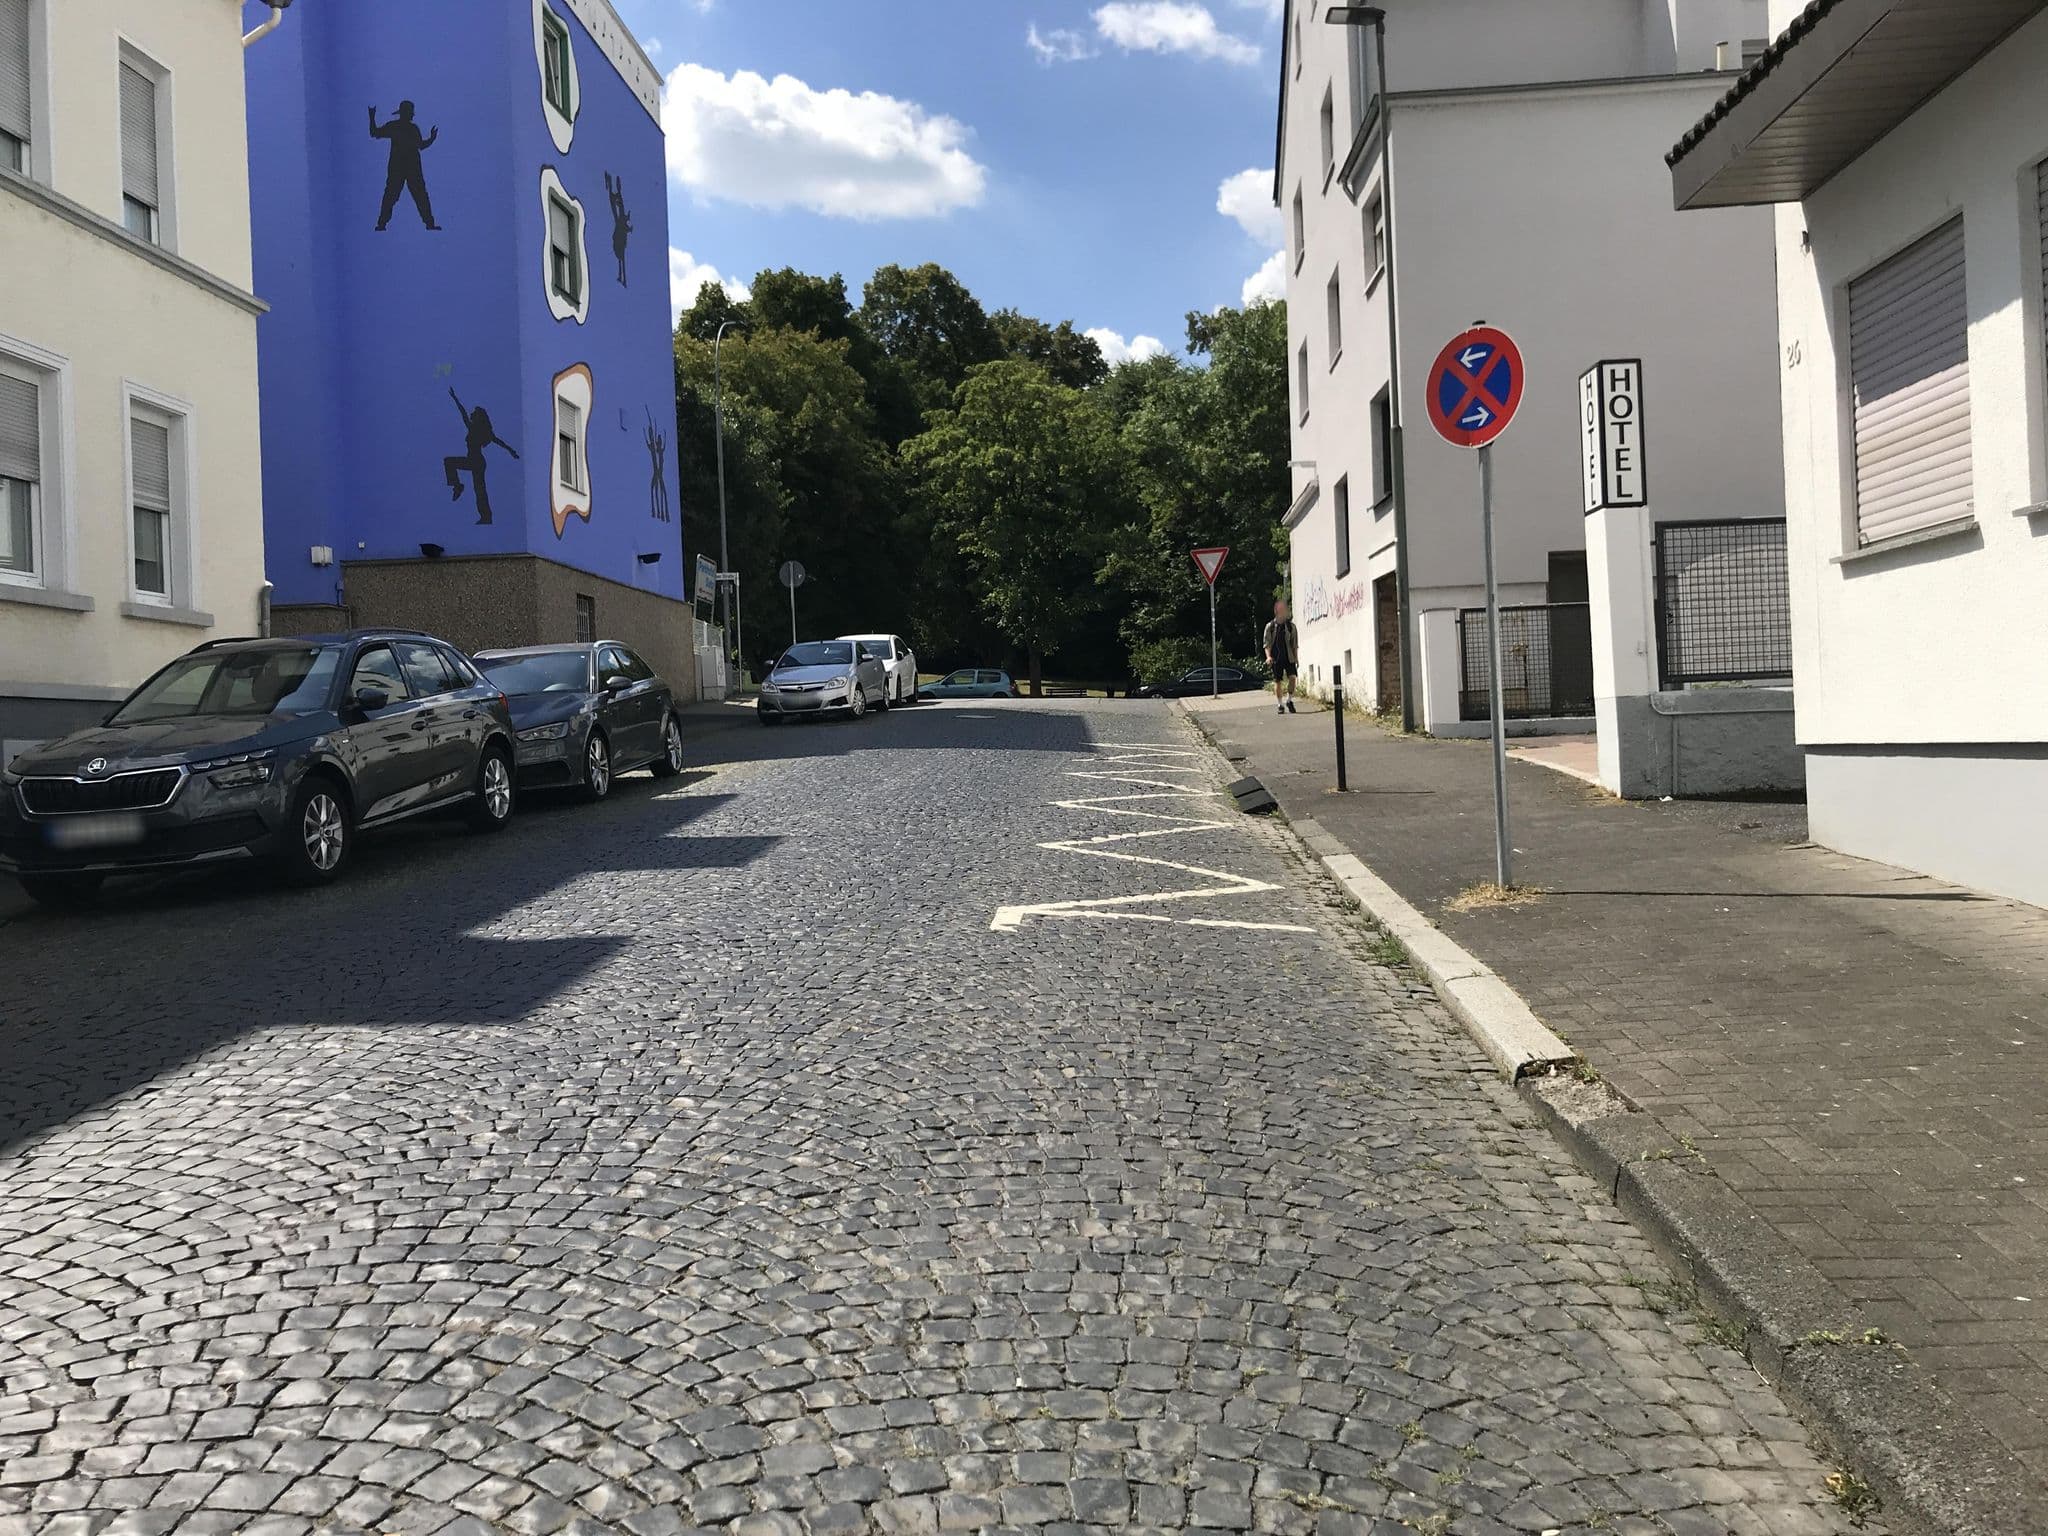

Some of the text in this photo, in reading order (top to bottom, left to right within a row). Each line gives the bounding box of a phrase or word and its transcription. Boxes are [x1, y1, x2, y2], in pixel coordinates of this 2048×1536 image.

[1787, 339, 1802, 369] 26
[1586, 374, 1596, 505] HOTEL
[1609, 368, 1633, 498] HOTEL
